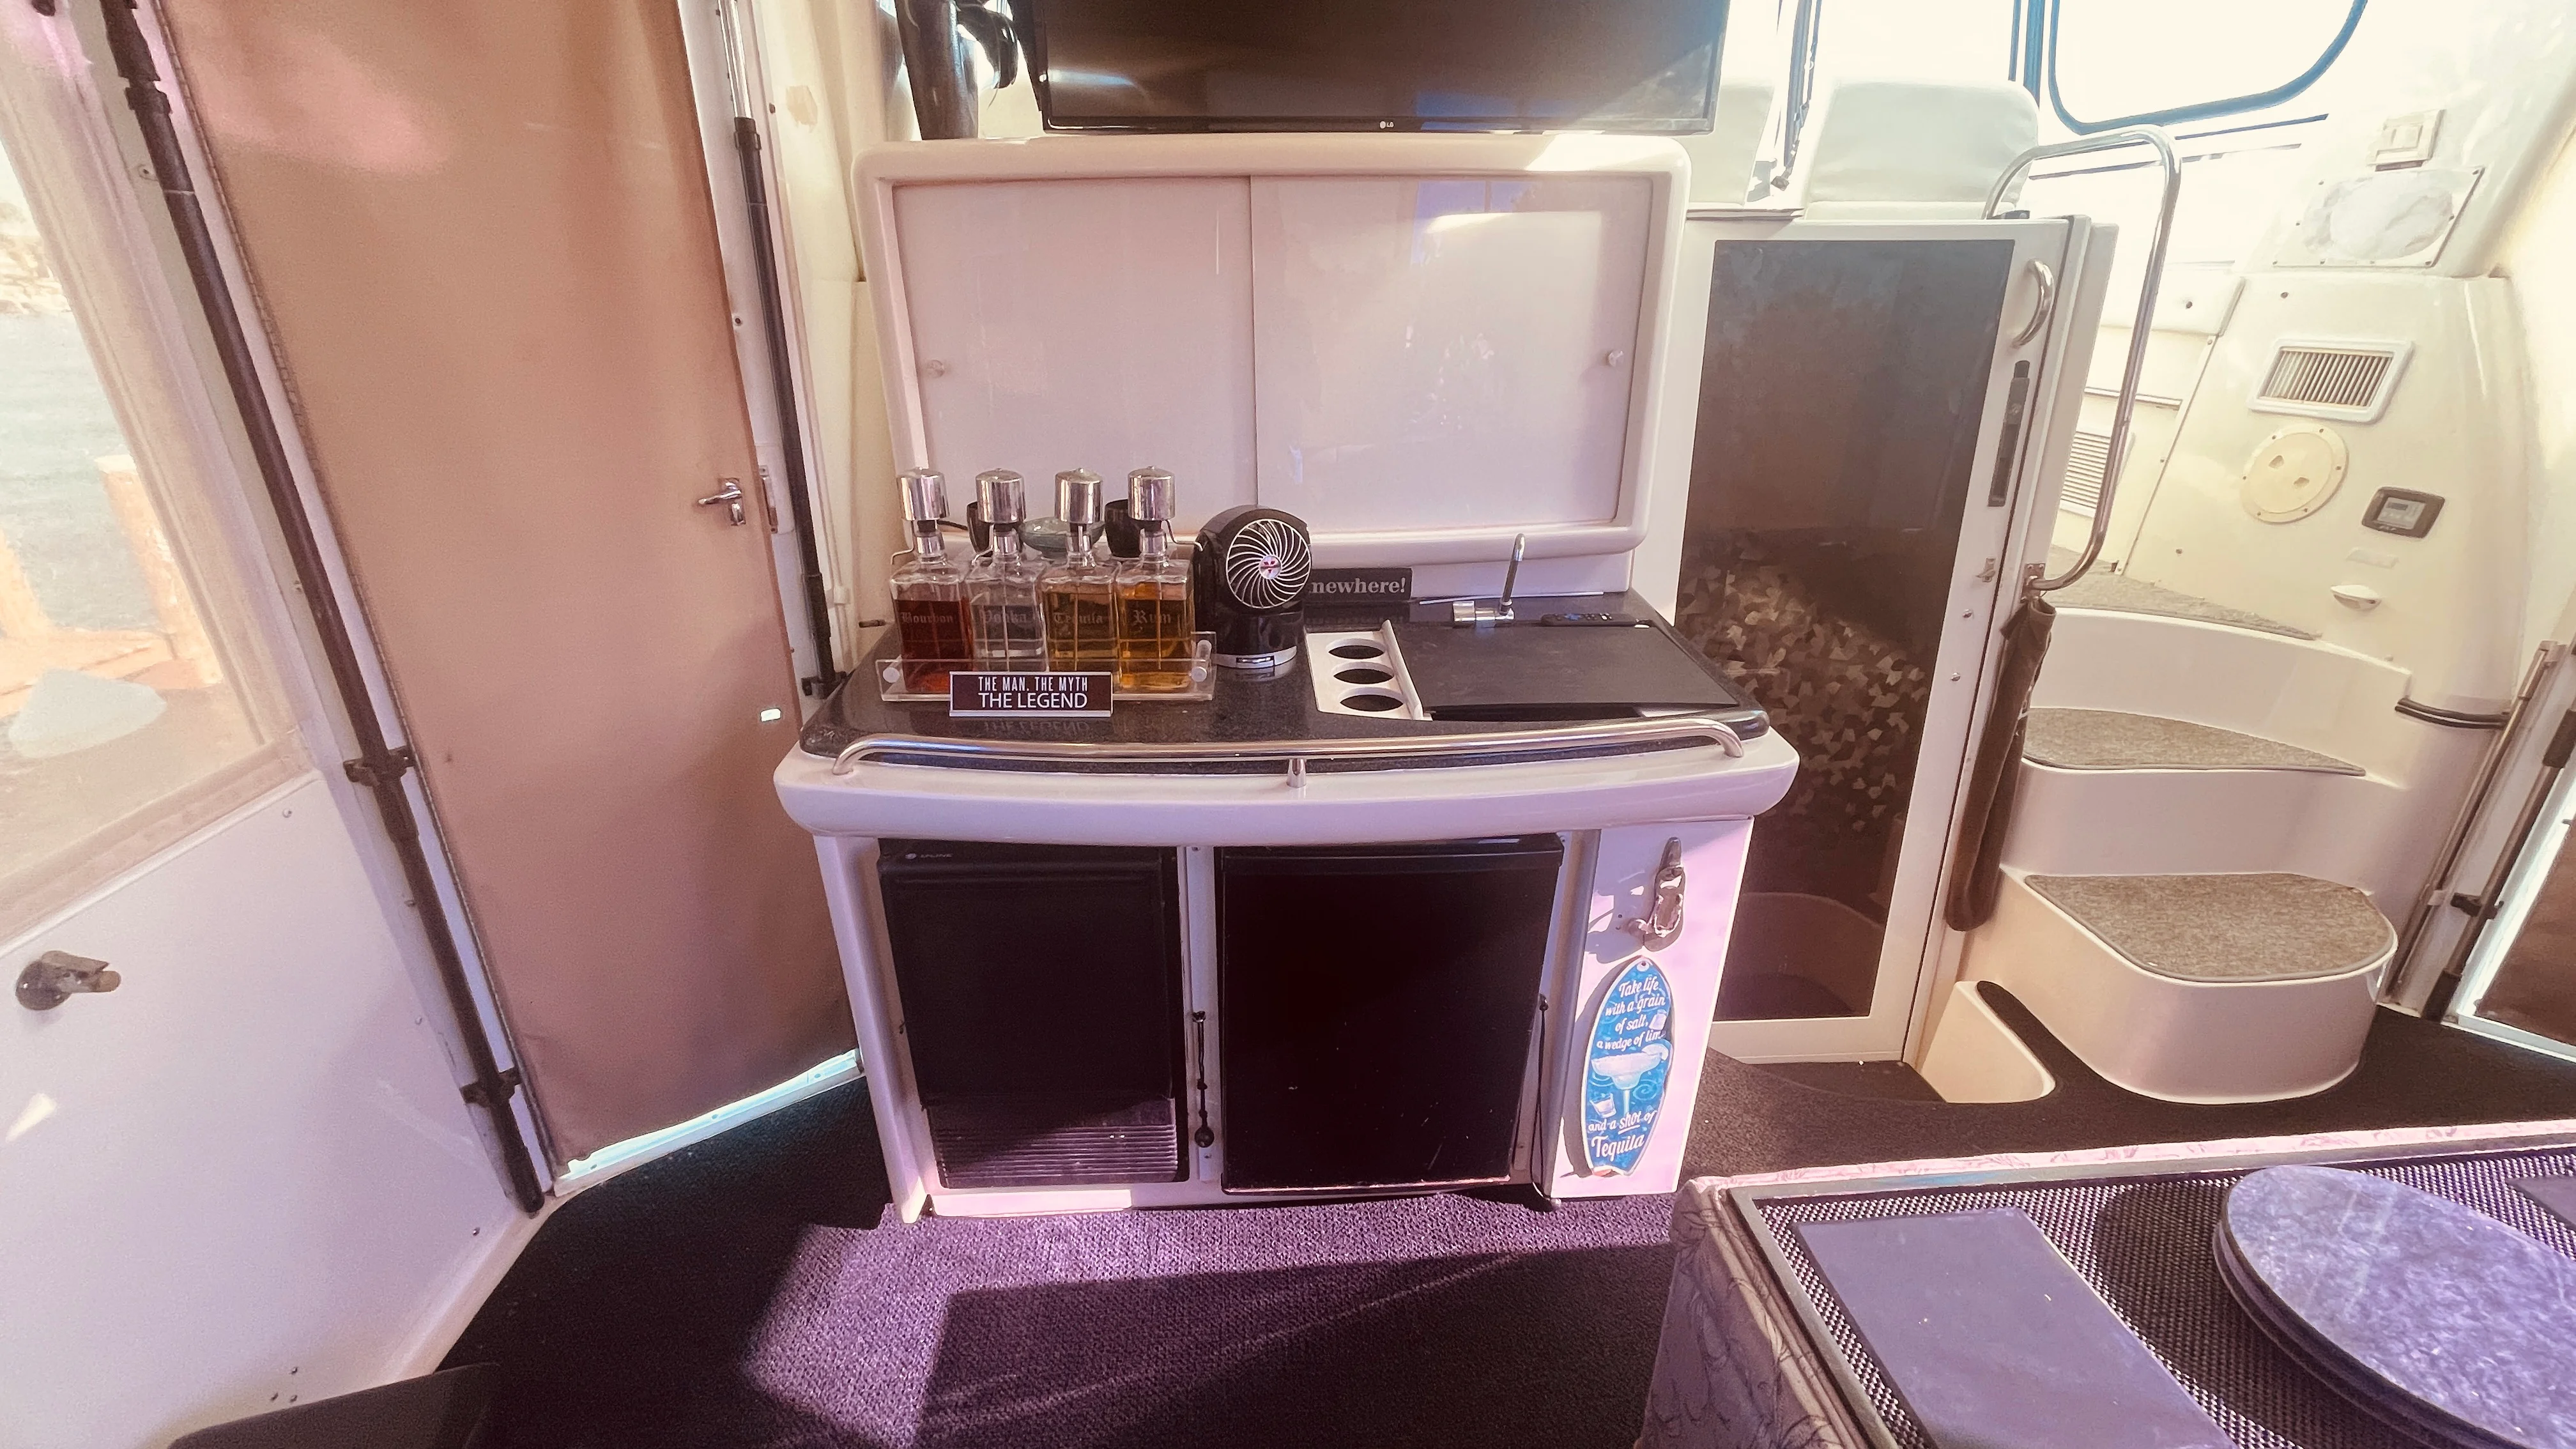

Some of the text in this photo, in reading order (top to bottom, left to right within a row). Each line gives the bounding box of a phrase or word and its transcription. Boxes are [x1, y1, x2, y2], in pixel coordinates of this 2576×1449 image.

[978, 676, 997, 691] THE
[1035, 676, 1054, 691] THE
[1059, 677, 1087, 692] MYTH
[978, 693, 1087, 708] THE LEGEND
[1619, 976, 1659, 997] Take life
[1605, 993, 1666, 1016] with a grain
[1615, 1013, 1648, 1034] of salt,
[1597, 1040, 1604, 1049] a
[1604, 1038, 1632, 1052] wedge
[1633, 1031, 1645, 1046] of
[1588, 1110, 1658, 1131] and a shot of
[1591, 1134, 1645, 1162] Tequila
